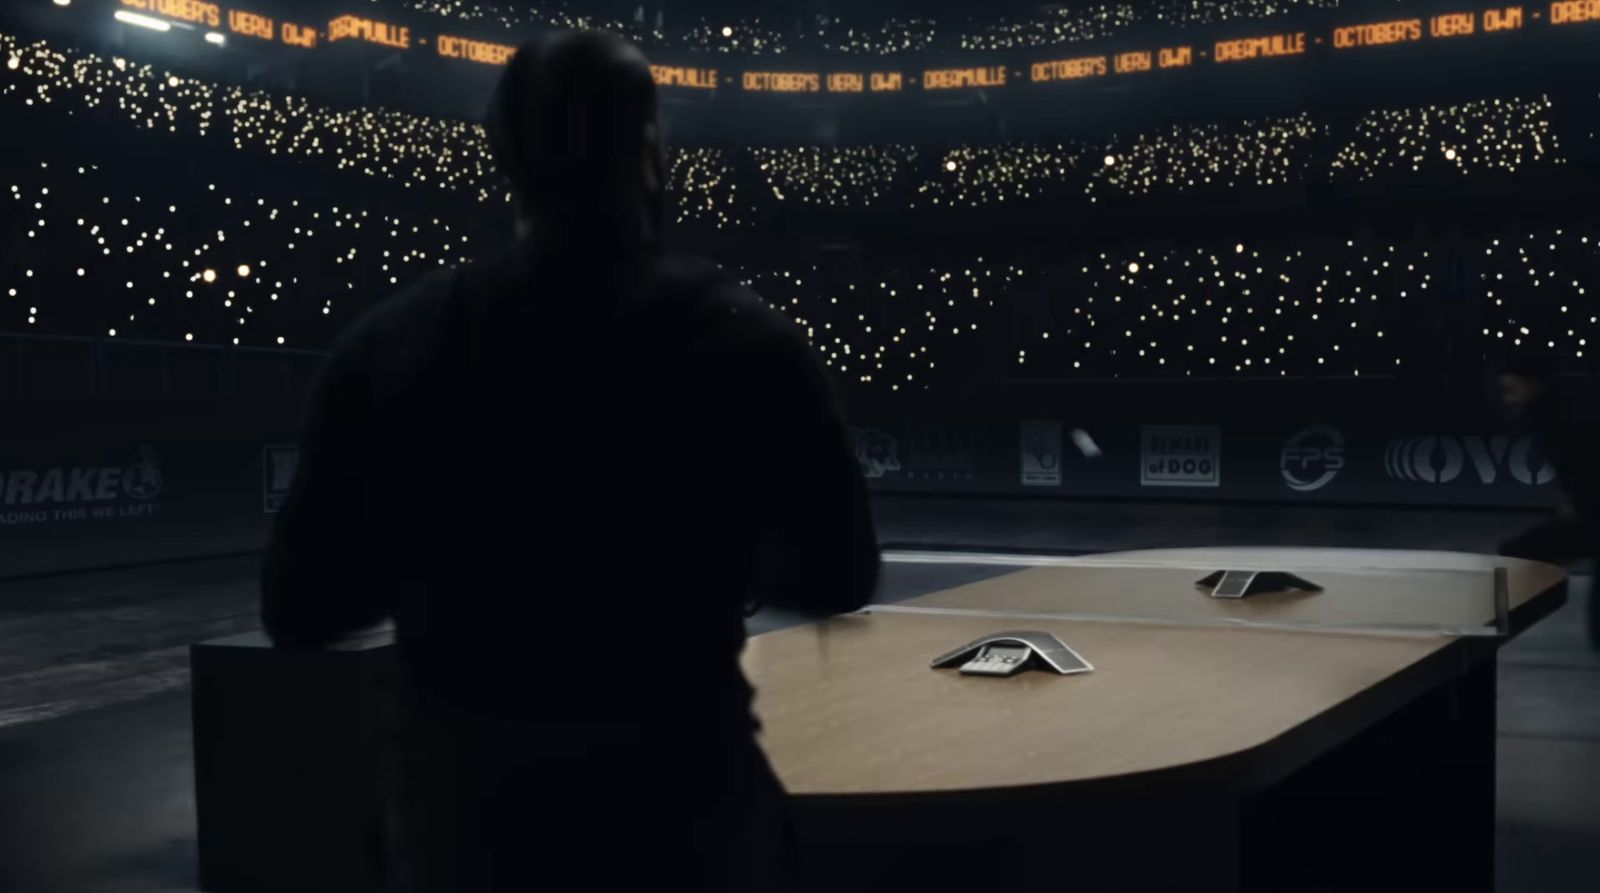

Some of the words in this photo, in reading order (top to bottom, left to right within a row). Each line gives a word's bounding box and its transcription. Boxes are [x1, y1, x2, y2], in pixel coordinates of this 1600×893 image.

[228, 10, 275, 40] VERY
[280, 22, 318, 48] OWN
[744, 71, 820, 92] OCTOBER'S
[828, 73, 864, 92] VERY
[871, 72, 902, 91] OWN
[924, 67, 1005, 89] DREAMVILLE
[1032, 56, 1107, 81] OCTOBER'S
[1114, 51, 1152, 73] VERY
[1158, 46, 1192, 68] OWN
[1214, 32, 1305, 62] DREAMVILLE
[1333, 18, 1422, 49] OCTOBER'S
[1429, 12, 1475, 38] VERY
[1482, 6, 1523, 32] OWN
[1169, 459, 1211, 474] DOG
[1280, 447, 1344, 469] FPS
[53, 508, 87, 520] THIS
[91, 506, 115, 518] WE
